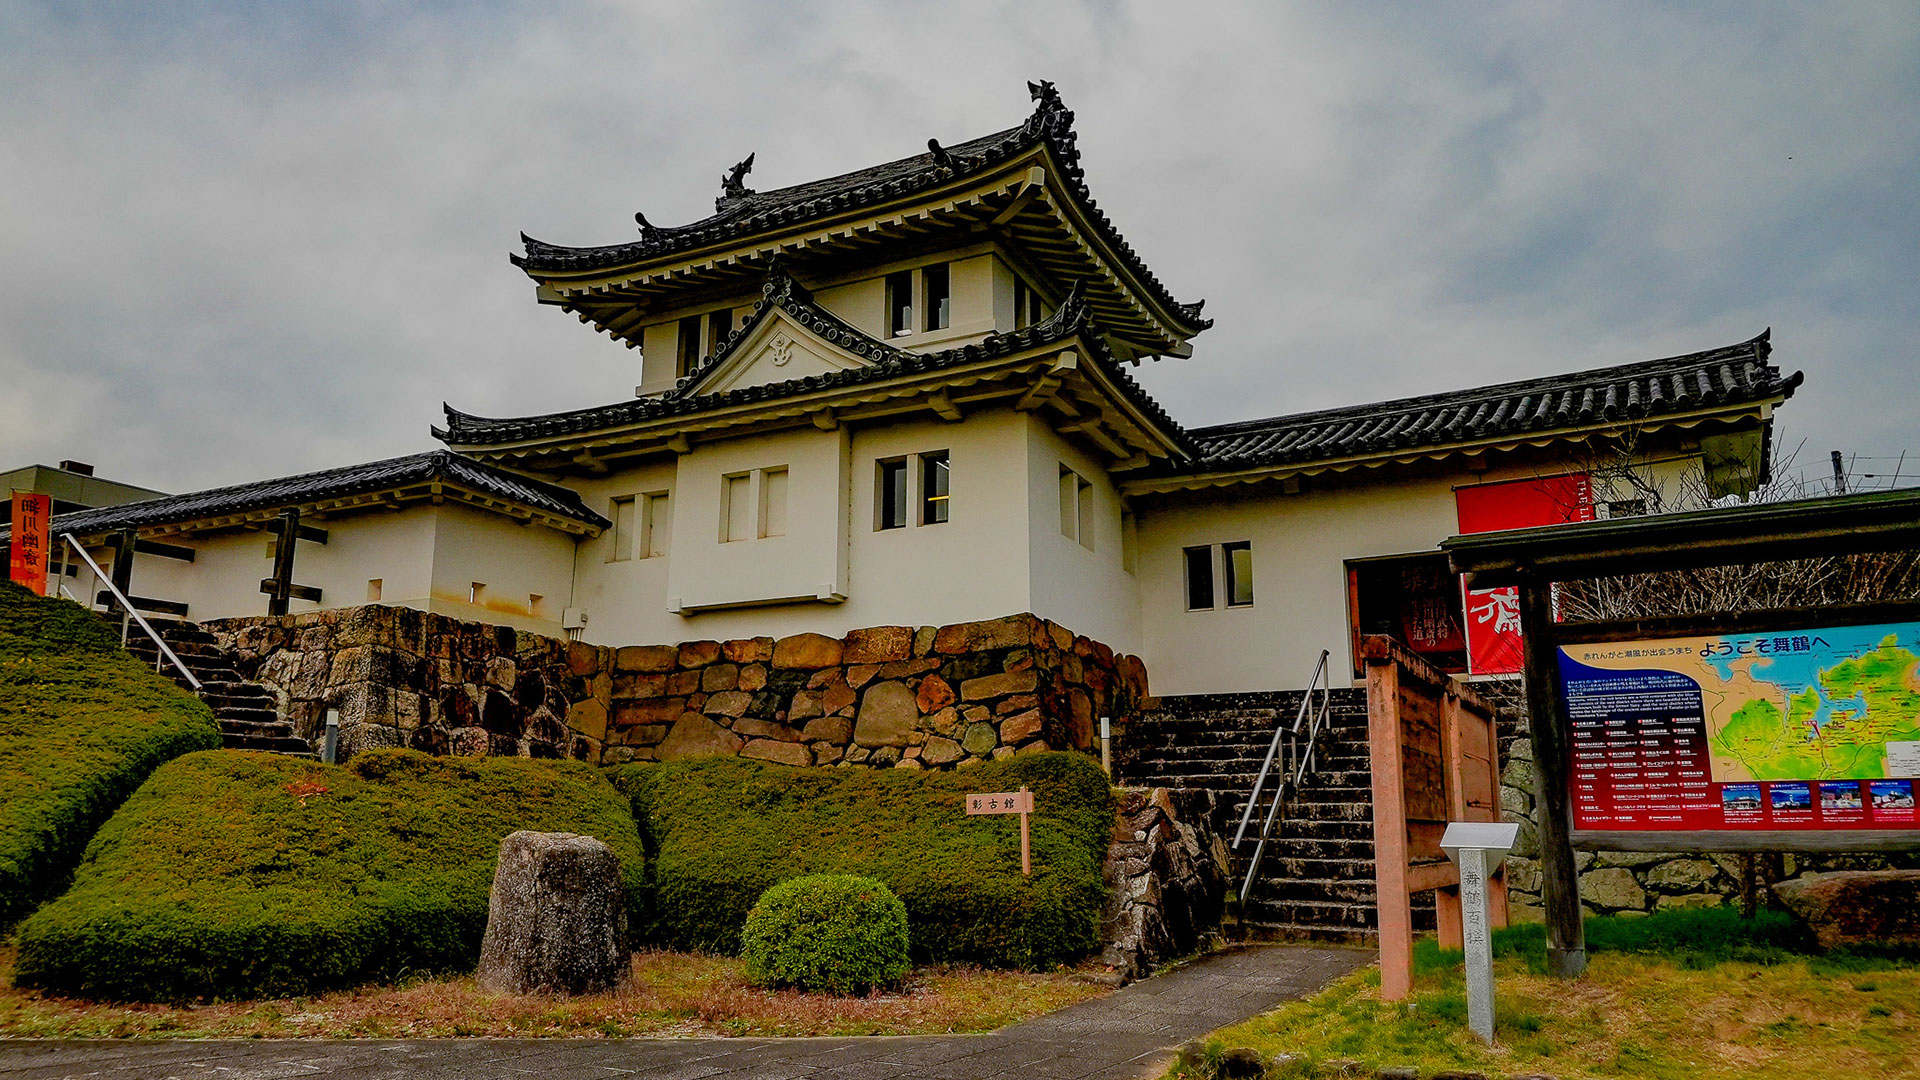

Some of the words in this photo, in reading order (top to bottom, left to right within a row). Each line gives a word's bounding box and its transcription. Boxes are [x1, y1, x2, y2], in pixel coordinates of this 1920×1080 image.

[1699, 636, 1831, 657] ようこそ舞鶴へ
[1583, 647, 1692, 661] 赤れんがと潮風が出会うまち
[972, 798, 1015, 810] 彰古館
